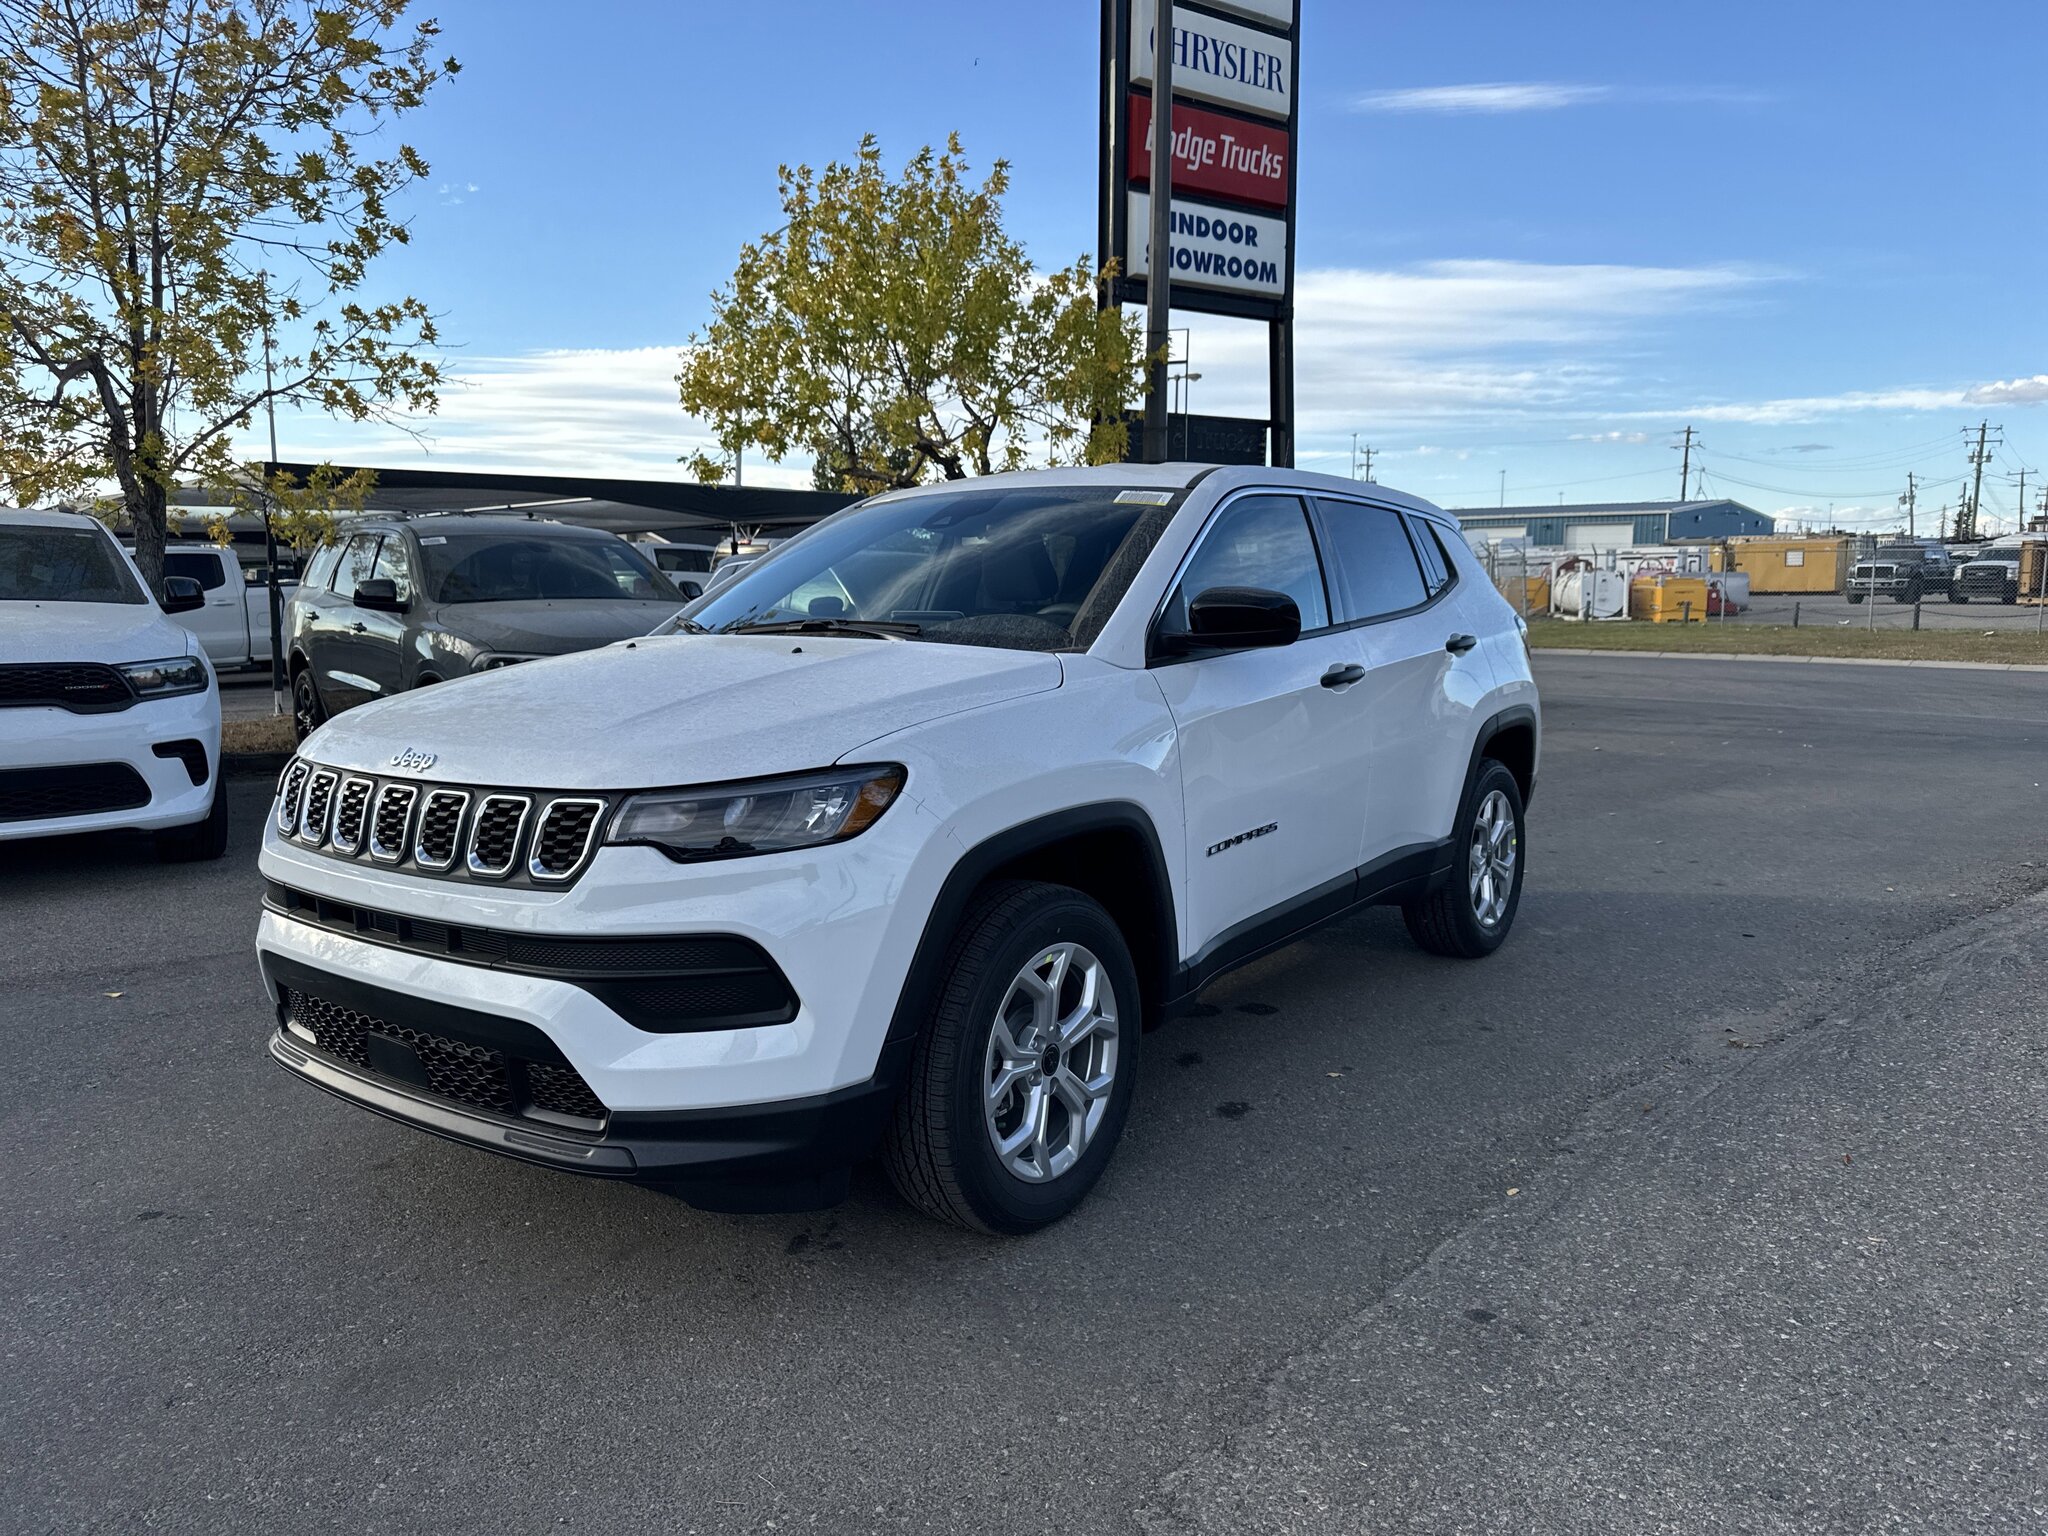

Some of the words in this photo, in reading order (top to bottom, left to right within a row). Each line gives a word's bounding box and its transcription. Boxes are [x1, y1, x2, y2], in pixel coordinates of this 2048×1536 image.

[1150, 26, 1285, 94] HRYSLER
[1220, 133, 1284, 179] Trucks
[1170, 211, 1258, 247] INDOOR
[1145, 244, 1277, 284] OWROOM
[390, 747, 438, 773] Jeep
[1206, 822, 1278, 857] COMPASS
